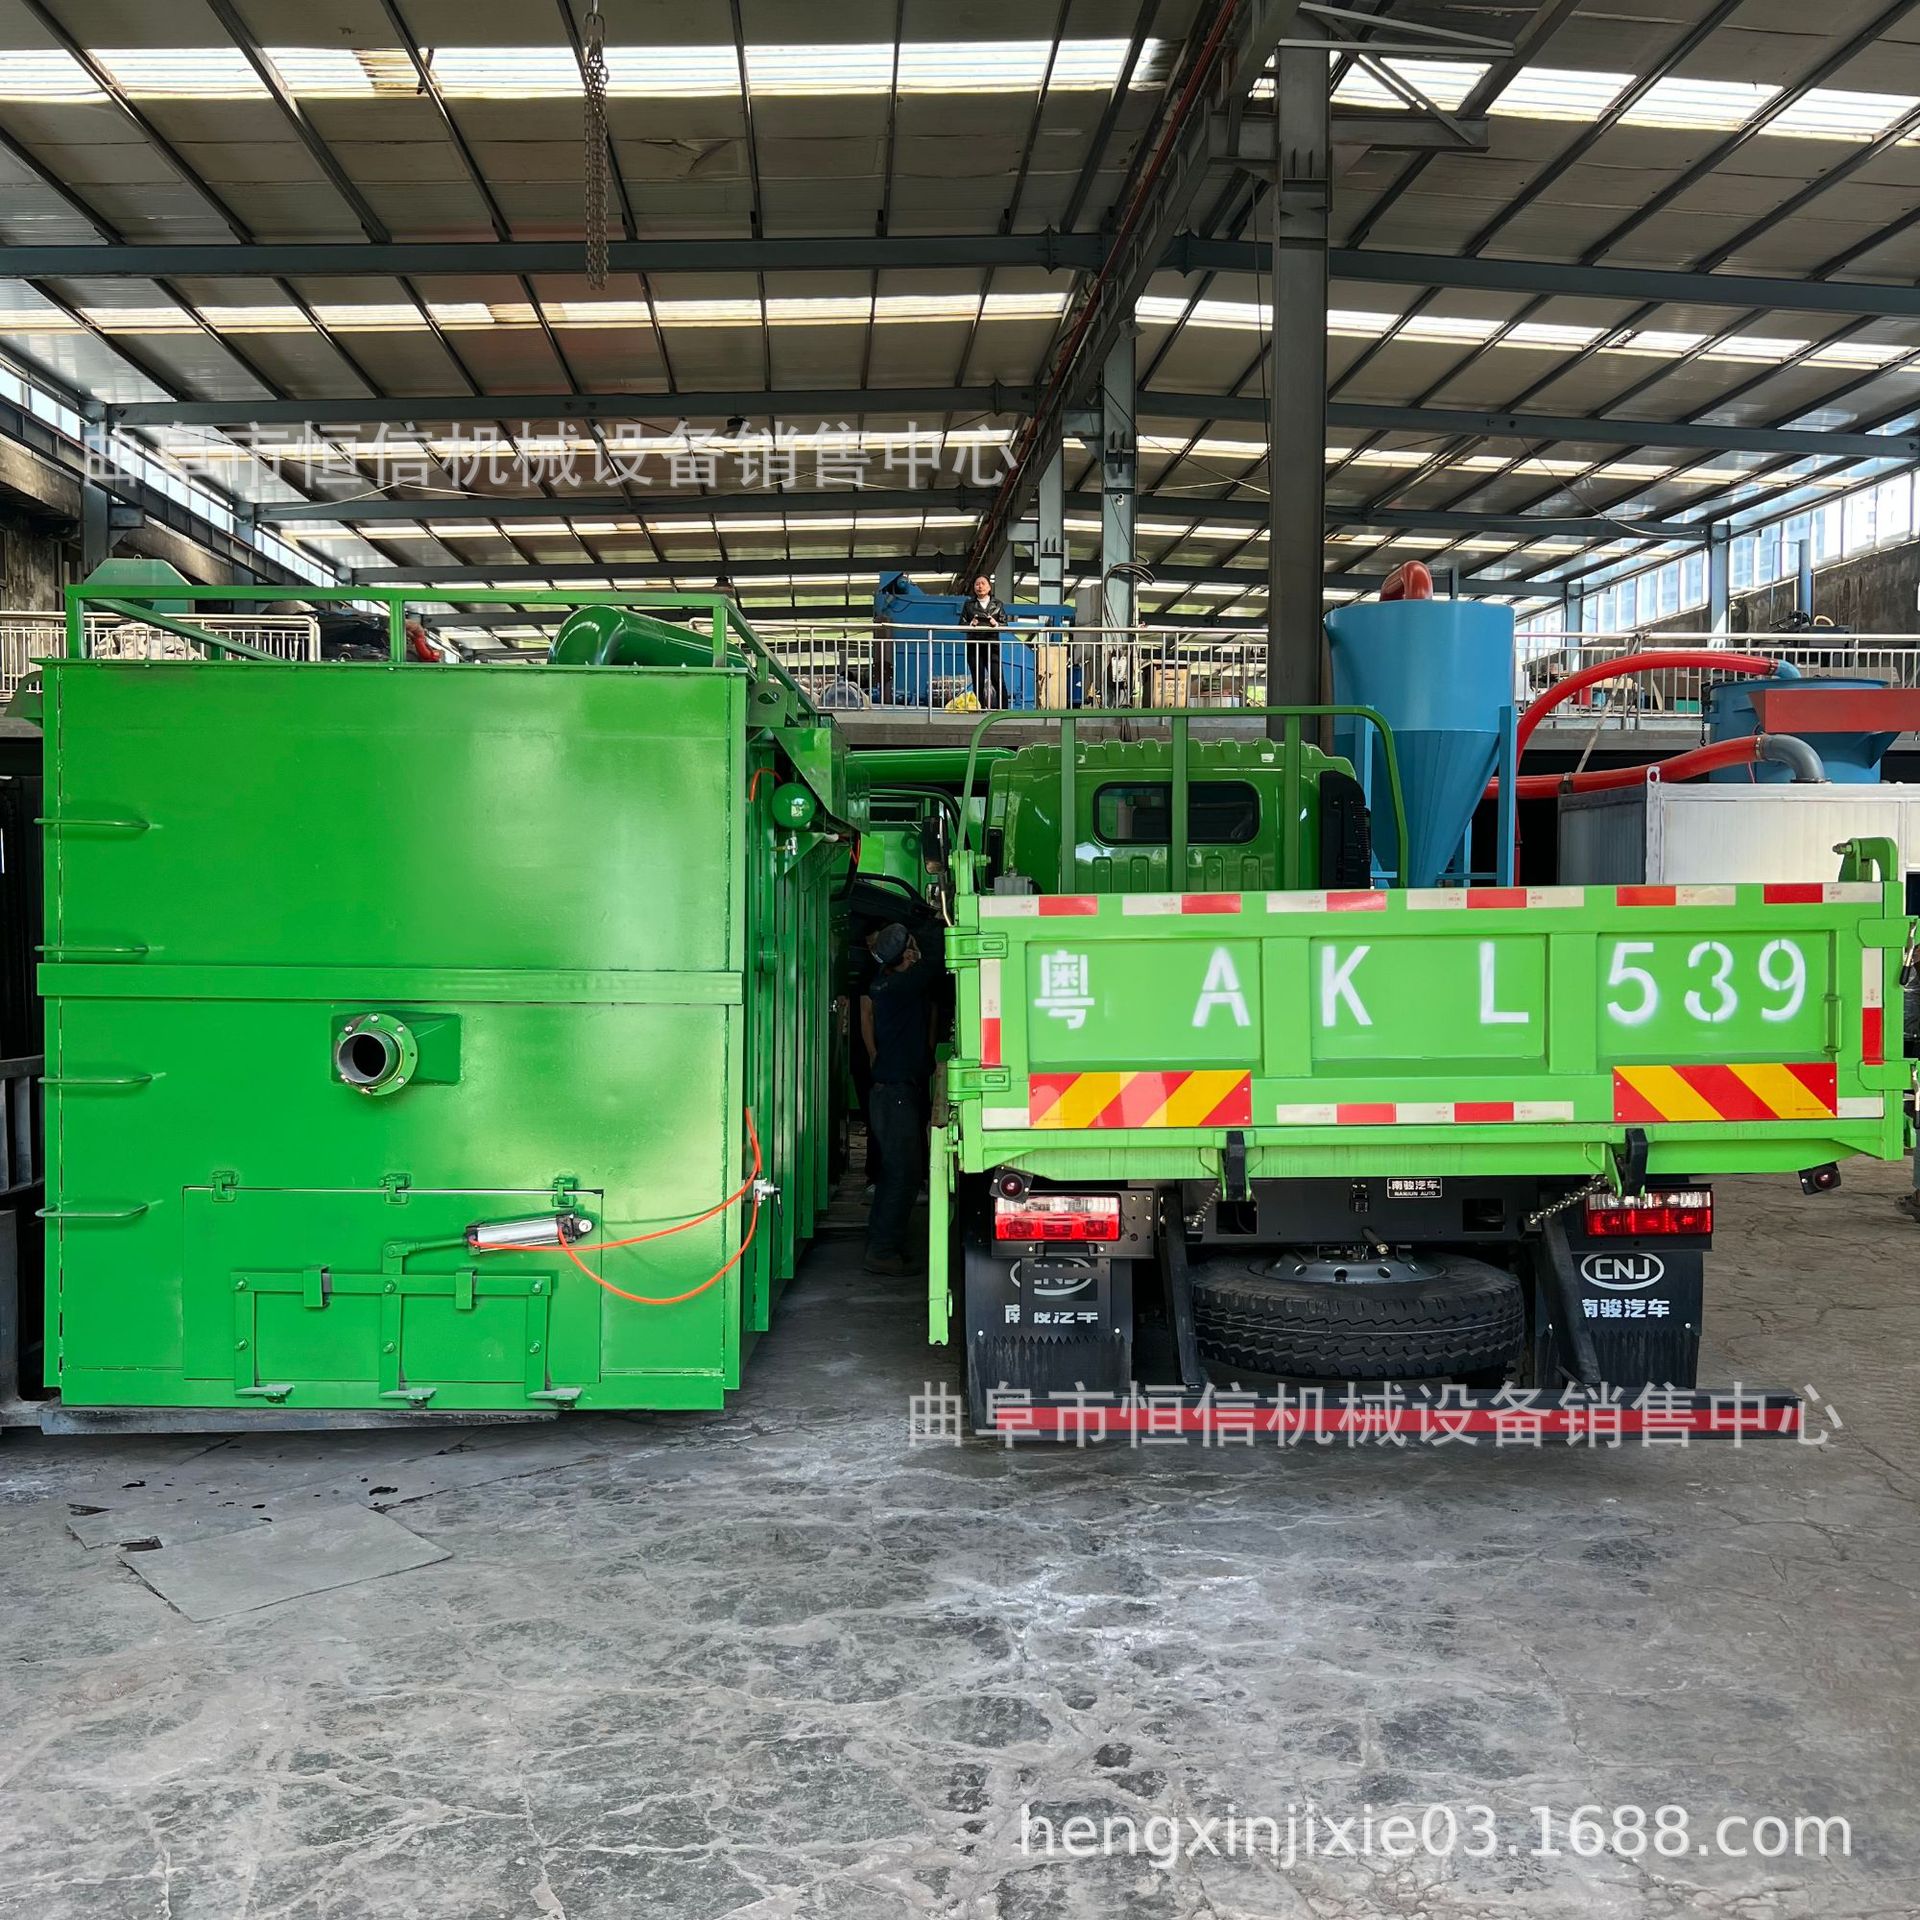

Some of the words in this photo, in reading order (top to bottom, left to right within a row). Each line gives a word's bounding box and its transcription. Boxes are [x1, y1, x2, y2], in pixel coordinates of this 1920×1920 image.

[1034, 949, 1095, 1029] 粤
[1192, 945, 1251, 1027] A
[1321, 945, 1373, 1027] K
[1479, 941, 1529, 1023] L
[1607, 939, 1807, 1024] 539
[1595, 1258, 1650, 1280] CNJ
